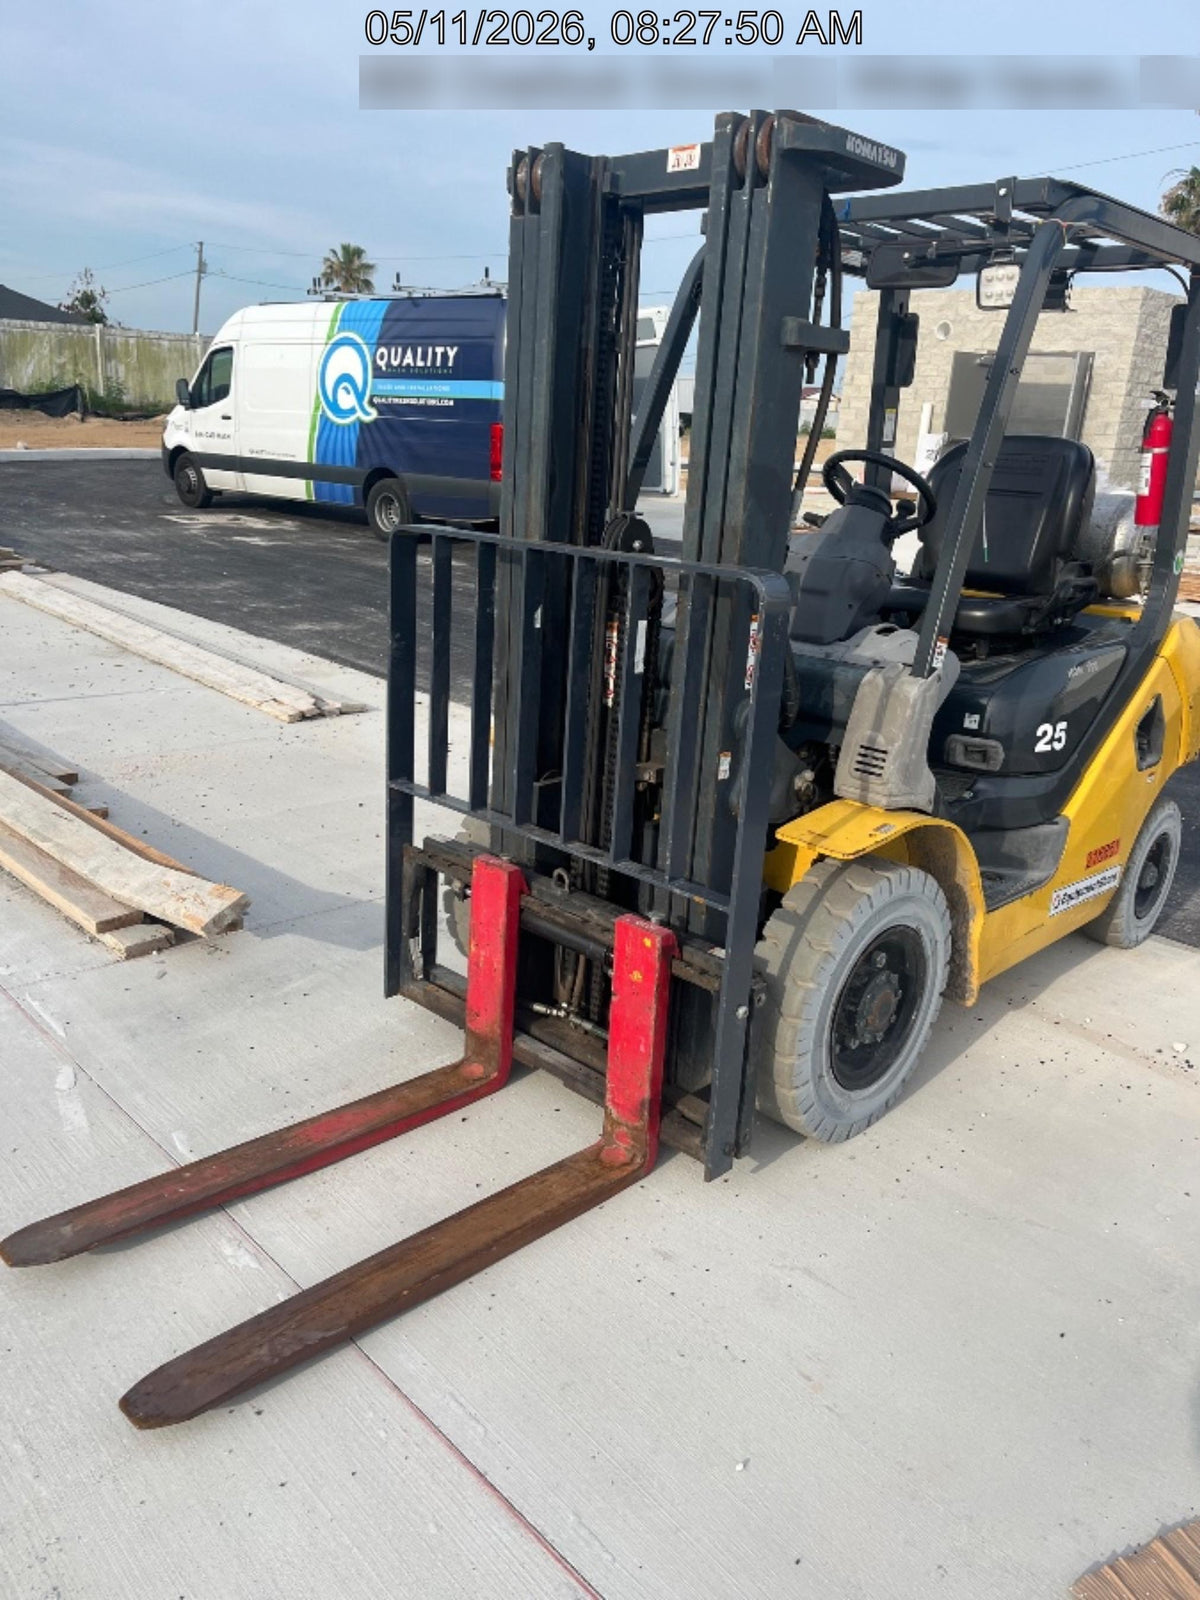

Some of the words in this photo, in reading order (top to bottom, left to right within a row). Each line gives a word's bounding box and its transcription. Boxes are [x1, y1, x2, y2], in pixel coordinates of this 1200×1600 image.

[845, 134, 897, 168] KOMATSU
[375, 345, 458, 371] QUALITY
[1034, 721, 1068, 753] 25
